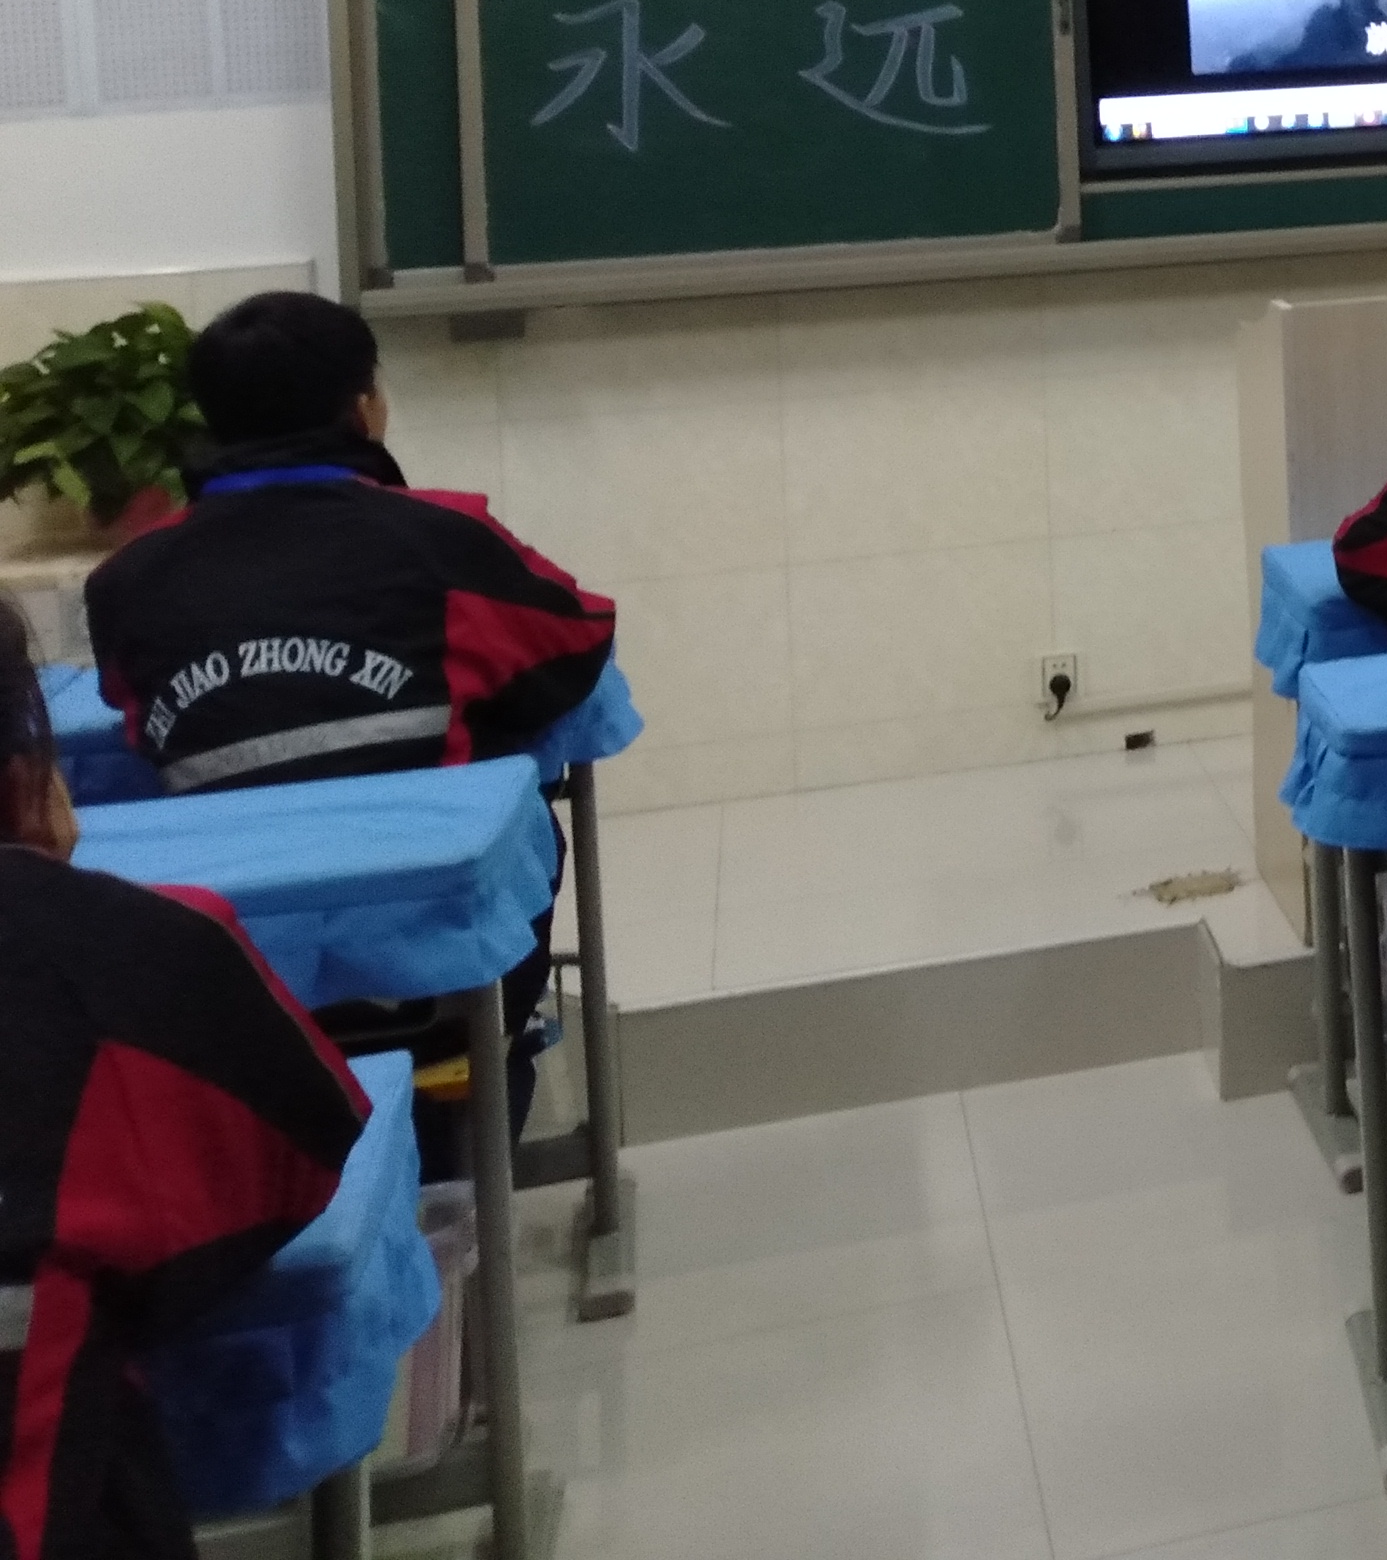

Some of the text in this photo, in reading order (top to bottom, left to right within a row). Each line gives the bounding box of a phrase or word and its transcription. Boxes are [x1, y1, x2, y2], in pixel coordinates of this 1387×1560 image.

[170, 650, 231, 710] JIAO
[238, 636, 351, 678] ZHONG
[348, 649, 415, 701] XIN
